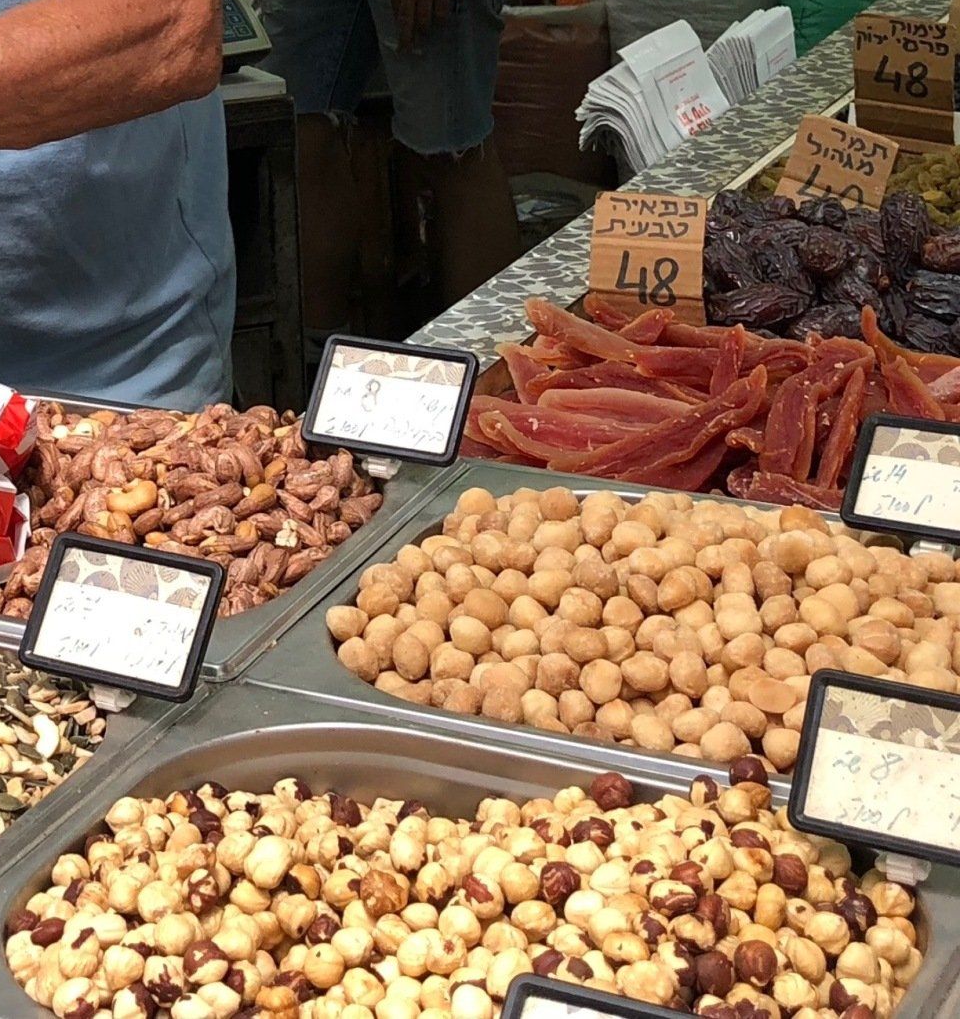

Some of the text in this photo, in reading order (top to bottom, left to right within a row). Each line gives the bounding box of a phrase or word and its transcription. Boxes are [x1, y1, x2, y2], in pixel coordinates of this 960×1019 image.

[873, 54, 929, 98] 48
[830, 126, 888, 160] תמר
[609, 196, 699, 217] פפאיה
[595, 219, 690, 239] טבעית
[615, 250, 680, 307] 48
